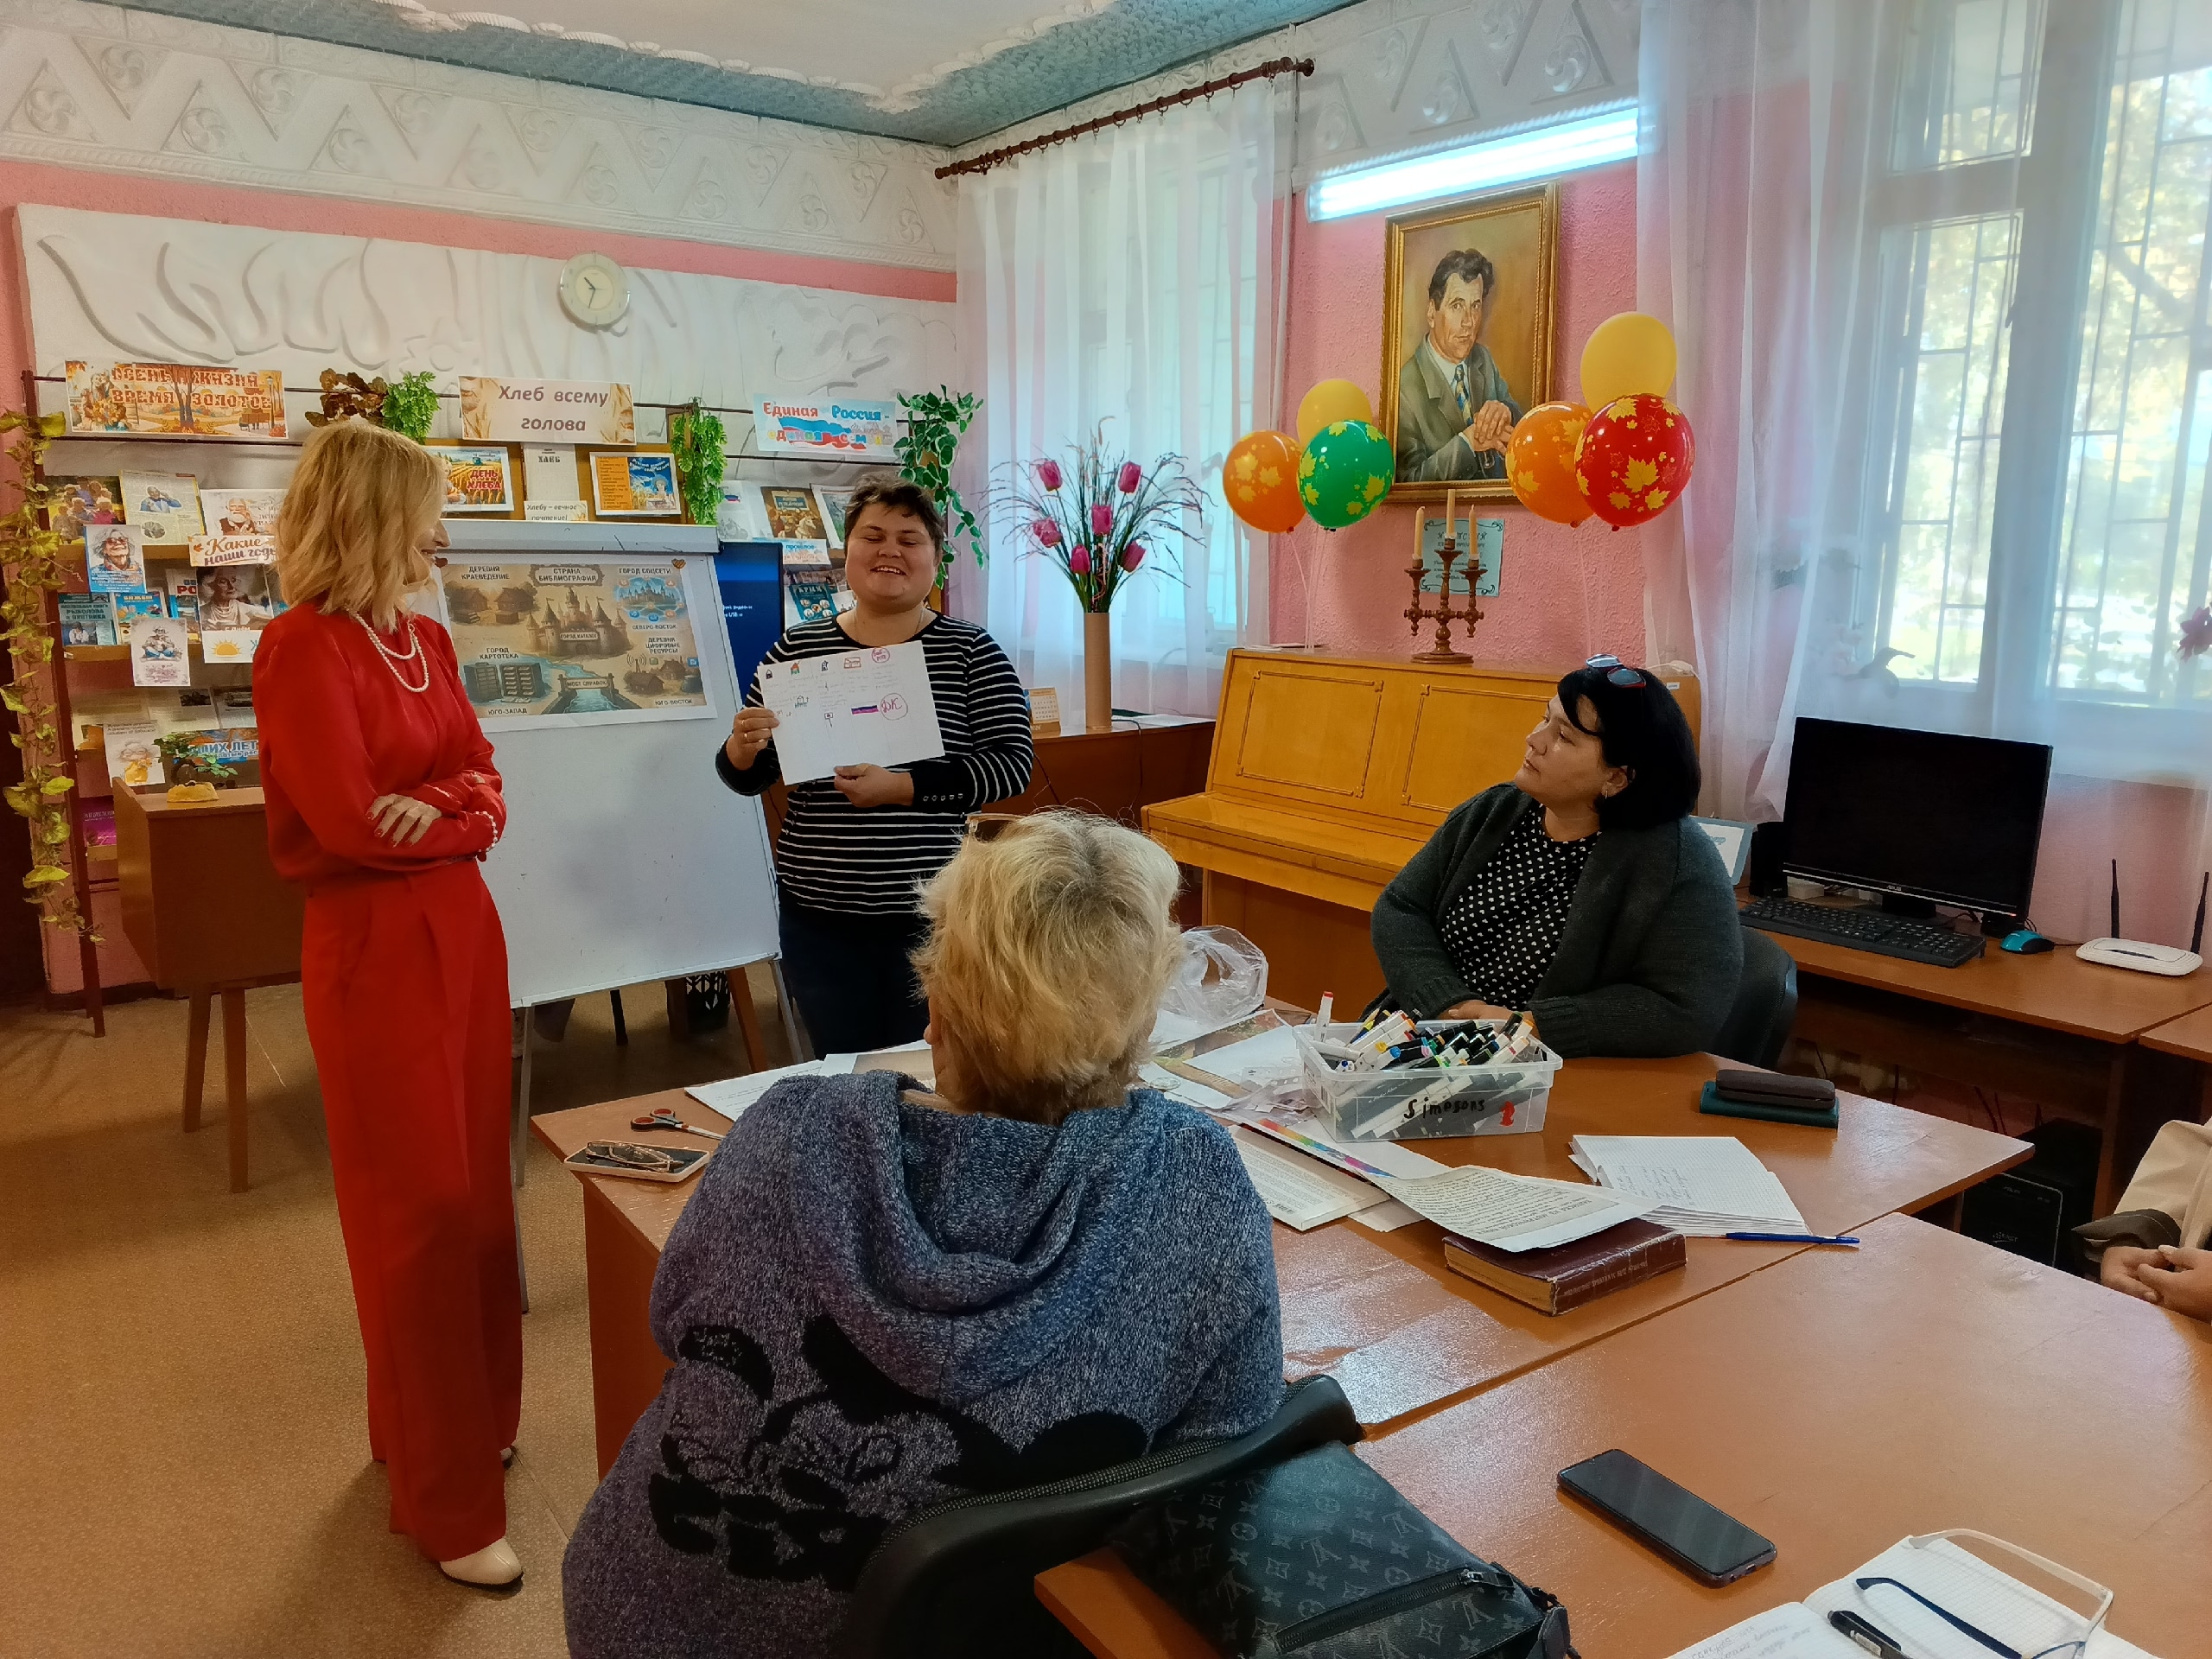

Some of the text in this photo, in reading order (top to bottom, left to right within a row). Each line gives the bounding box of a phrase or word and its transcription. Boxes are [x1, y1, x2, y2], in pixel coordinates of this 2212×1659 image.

[112, 391, 272, 409] ВРЕМЯ ЗОЛОТОЕ
[499, 385, 608, 407] Хлеб всему
[763, 403, 818, 417] Единая
[831, 405, 881, 421] Россия
[521, 417, 586, 431] голова
[471, 469, 498, 479] ДЕНЬ
[467, 480, 501, 489] ХЛЕБА
[204, 537, 262, 556] Какие
[204, 550, 245, 567] наши
[231, 741, 257, 752] ЛЕТ
